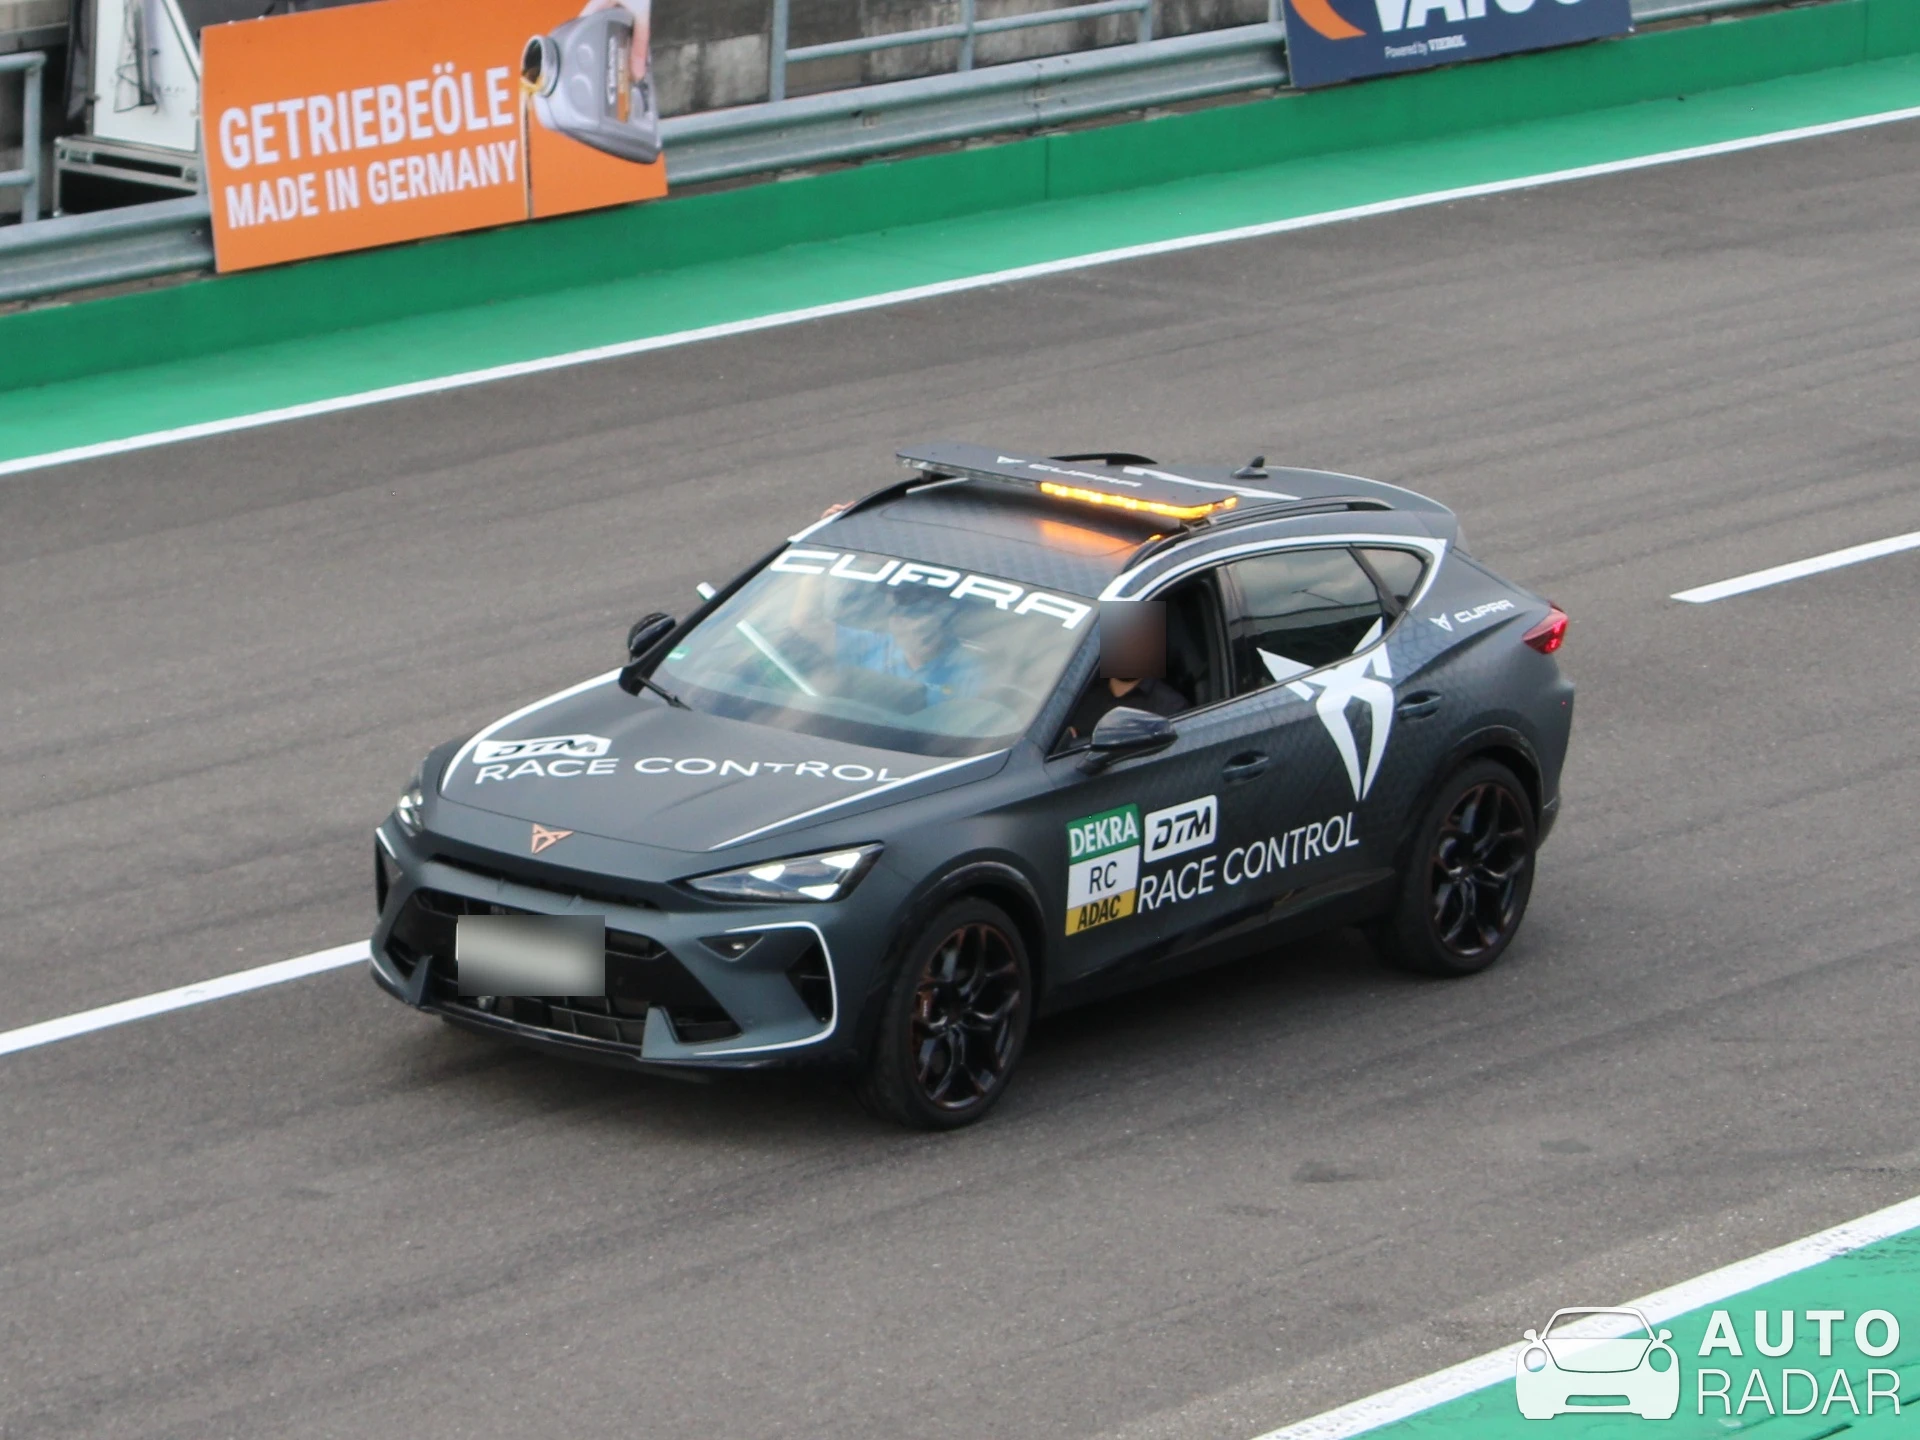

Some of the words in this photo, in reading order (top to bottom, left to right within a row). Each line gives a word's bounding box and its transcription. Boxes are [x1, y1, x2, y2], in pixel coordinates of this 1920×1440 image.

[219, 62, 514, 170] GETRIEBEÖLE
[224, 172, 320, 230] MADE
[324, 166, 362, 213] IN
[366, 139, 519, 206] GERMANY
[770, 549, 1092, 631] CUPRA
[1453, 599, 1515, 623] CUPRA
[474, 757, 620, 785] RACE
[634, 757, 904, 782] CONTROL
[488, 738, 599, 758] DTM
[1069, 811, 1139, 859] DEKRA
[1151, 804, 1212, 852] DTM
[1089, 860, 1118, 895] RC
[1137, 855, 1218, 914] RACE
[1223, 811, 1360, 886] CONTROL
[1077, 895, 1121, 931] ADAC
